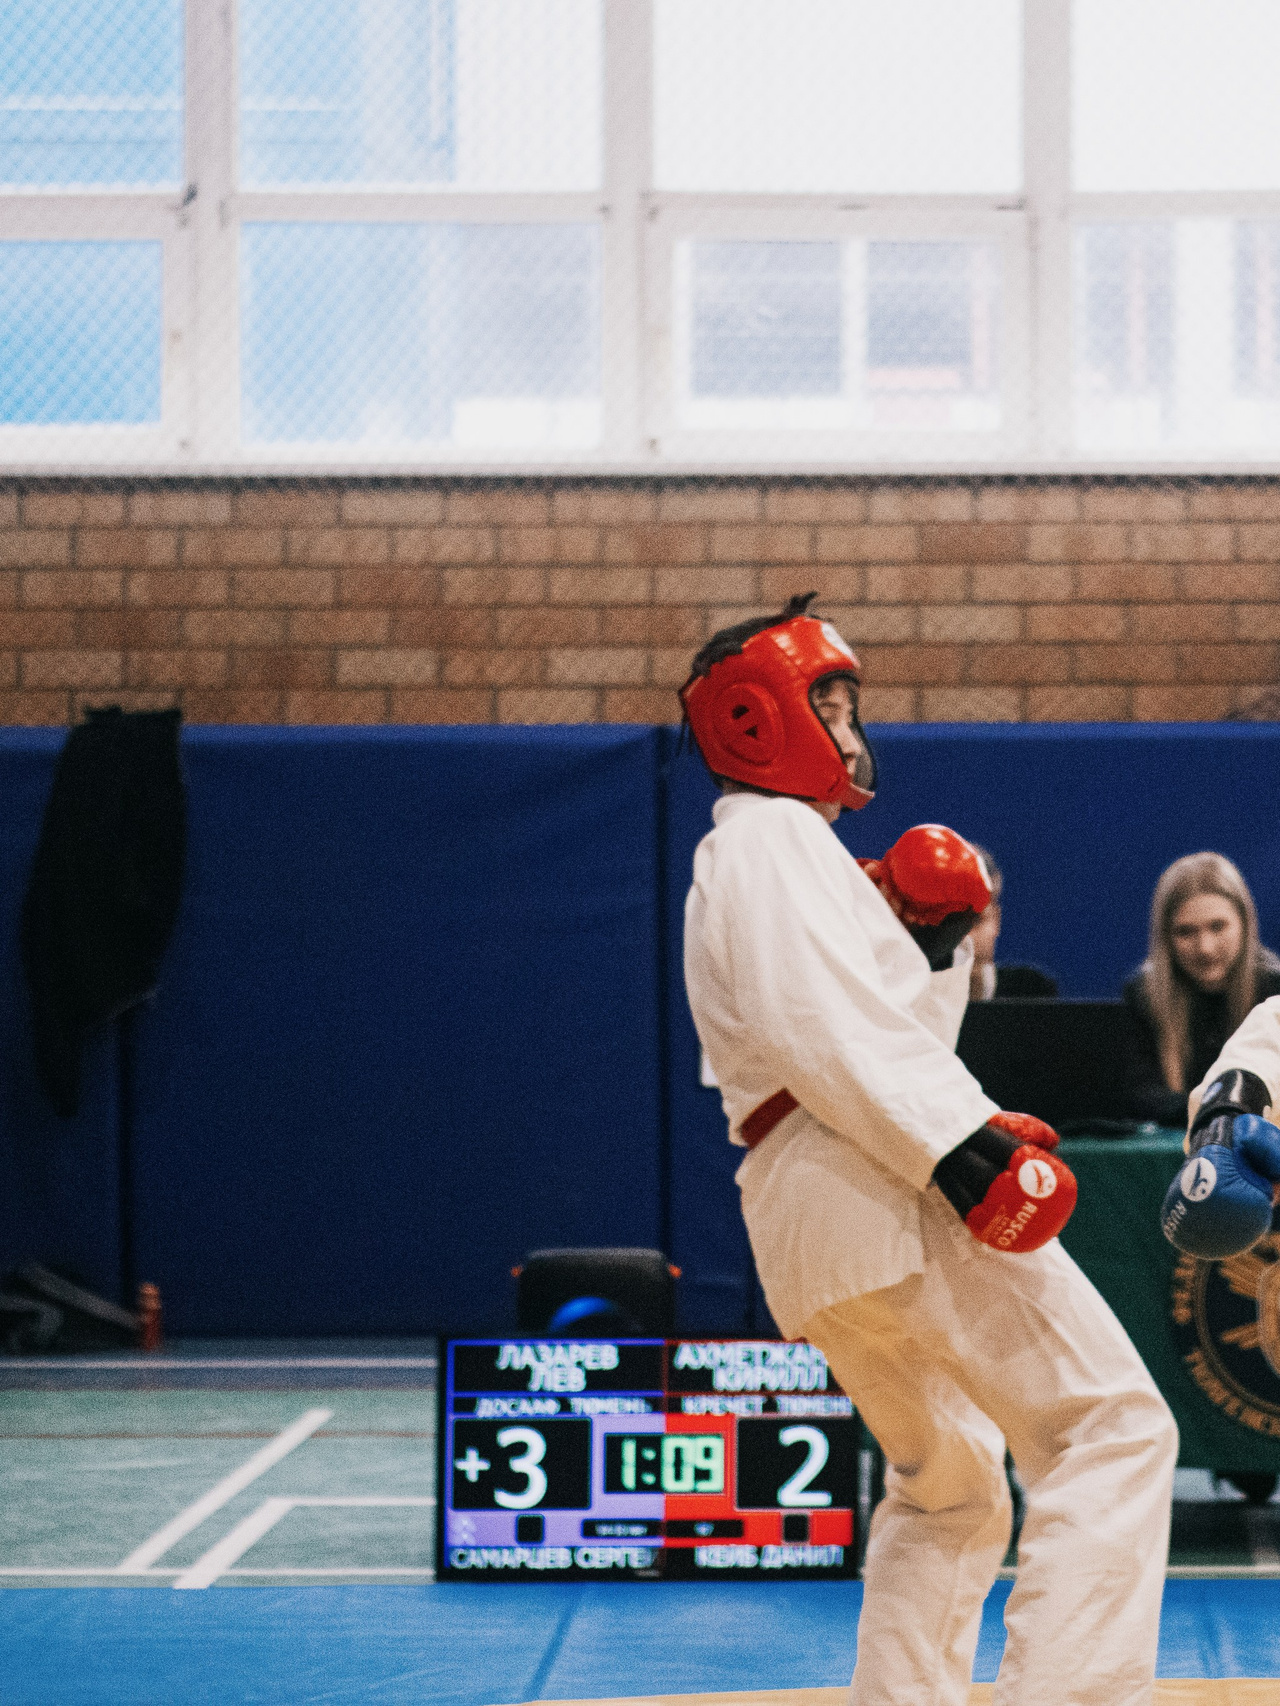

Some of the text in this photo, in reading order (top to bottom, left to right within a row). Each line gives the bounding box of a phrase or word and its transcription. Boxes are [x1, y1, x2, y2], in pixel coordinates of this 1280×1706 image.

[998, 1201, 1038, 1247] RUSCO
[497, 1344, 620, 1370] ЛАЗАРЕВ
[528, 1366, 587, 1392] ЛЕВ
[712, 1364, 828, 1392] КИРИЛЛ
[620, 1436, 725, 1493] 1:09
[777, 1425, 832, 1507] 2
[574, 1547, 657, 1569] СЕРГЕ
